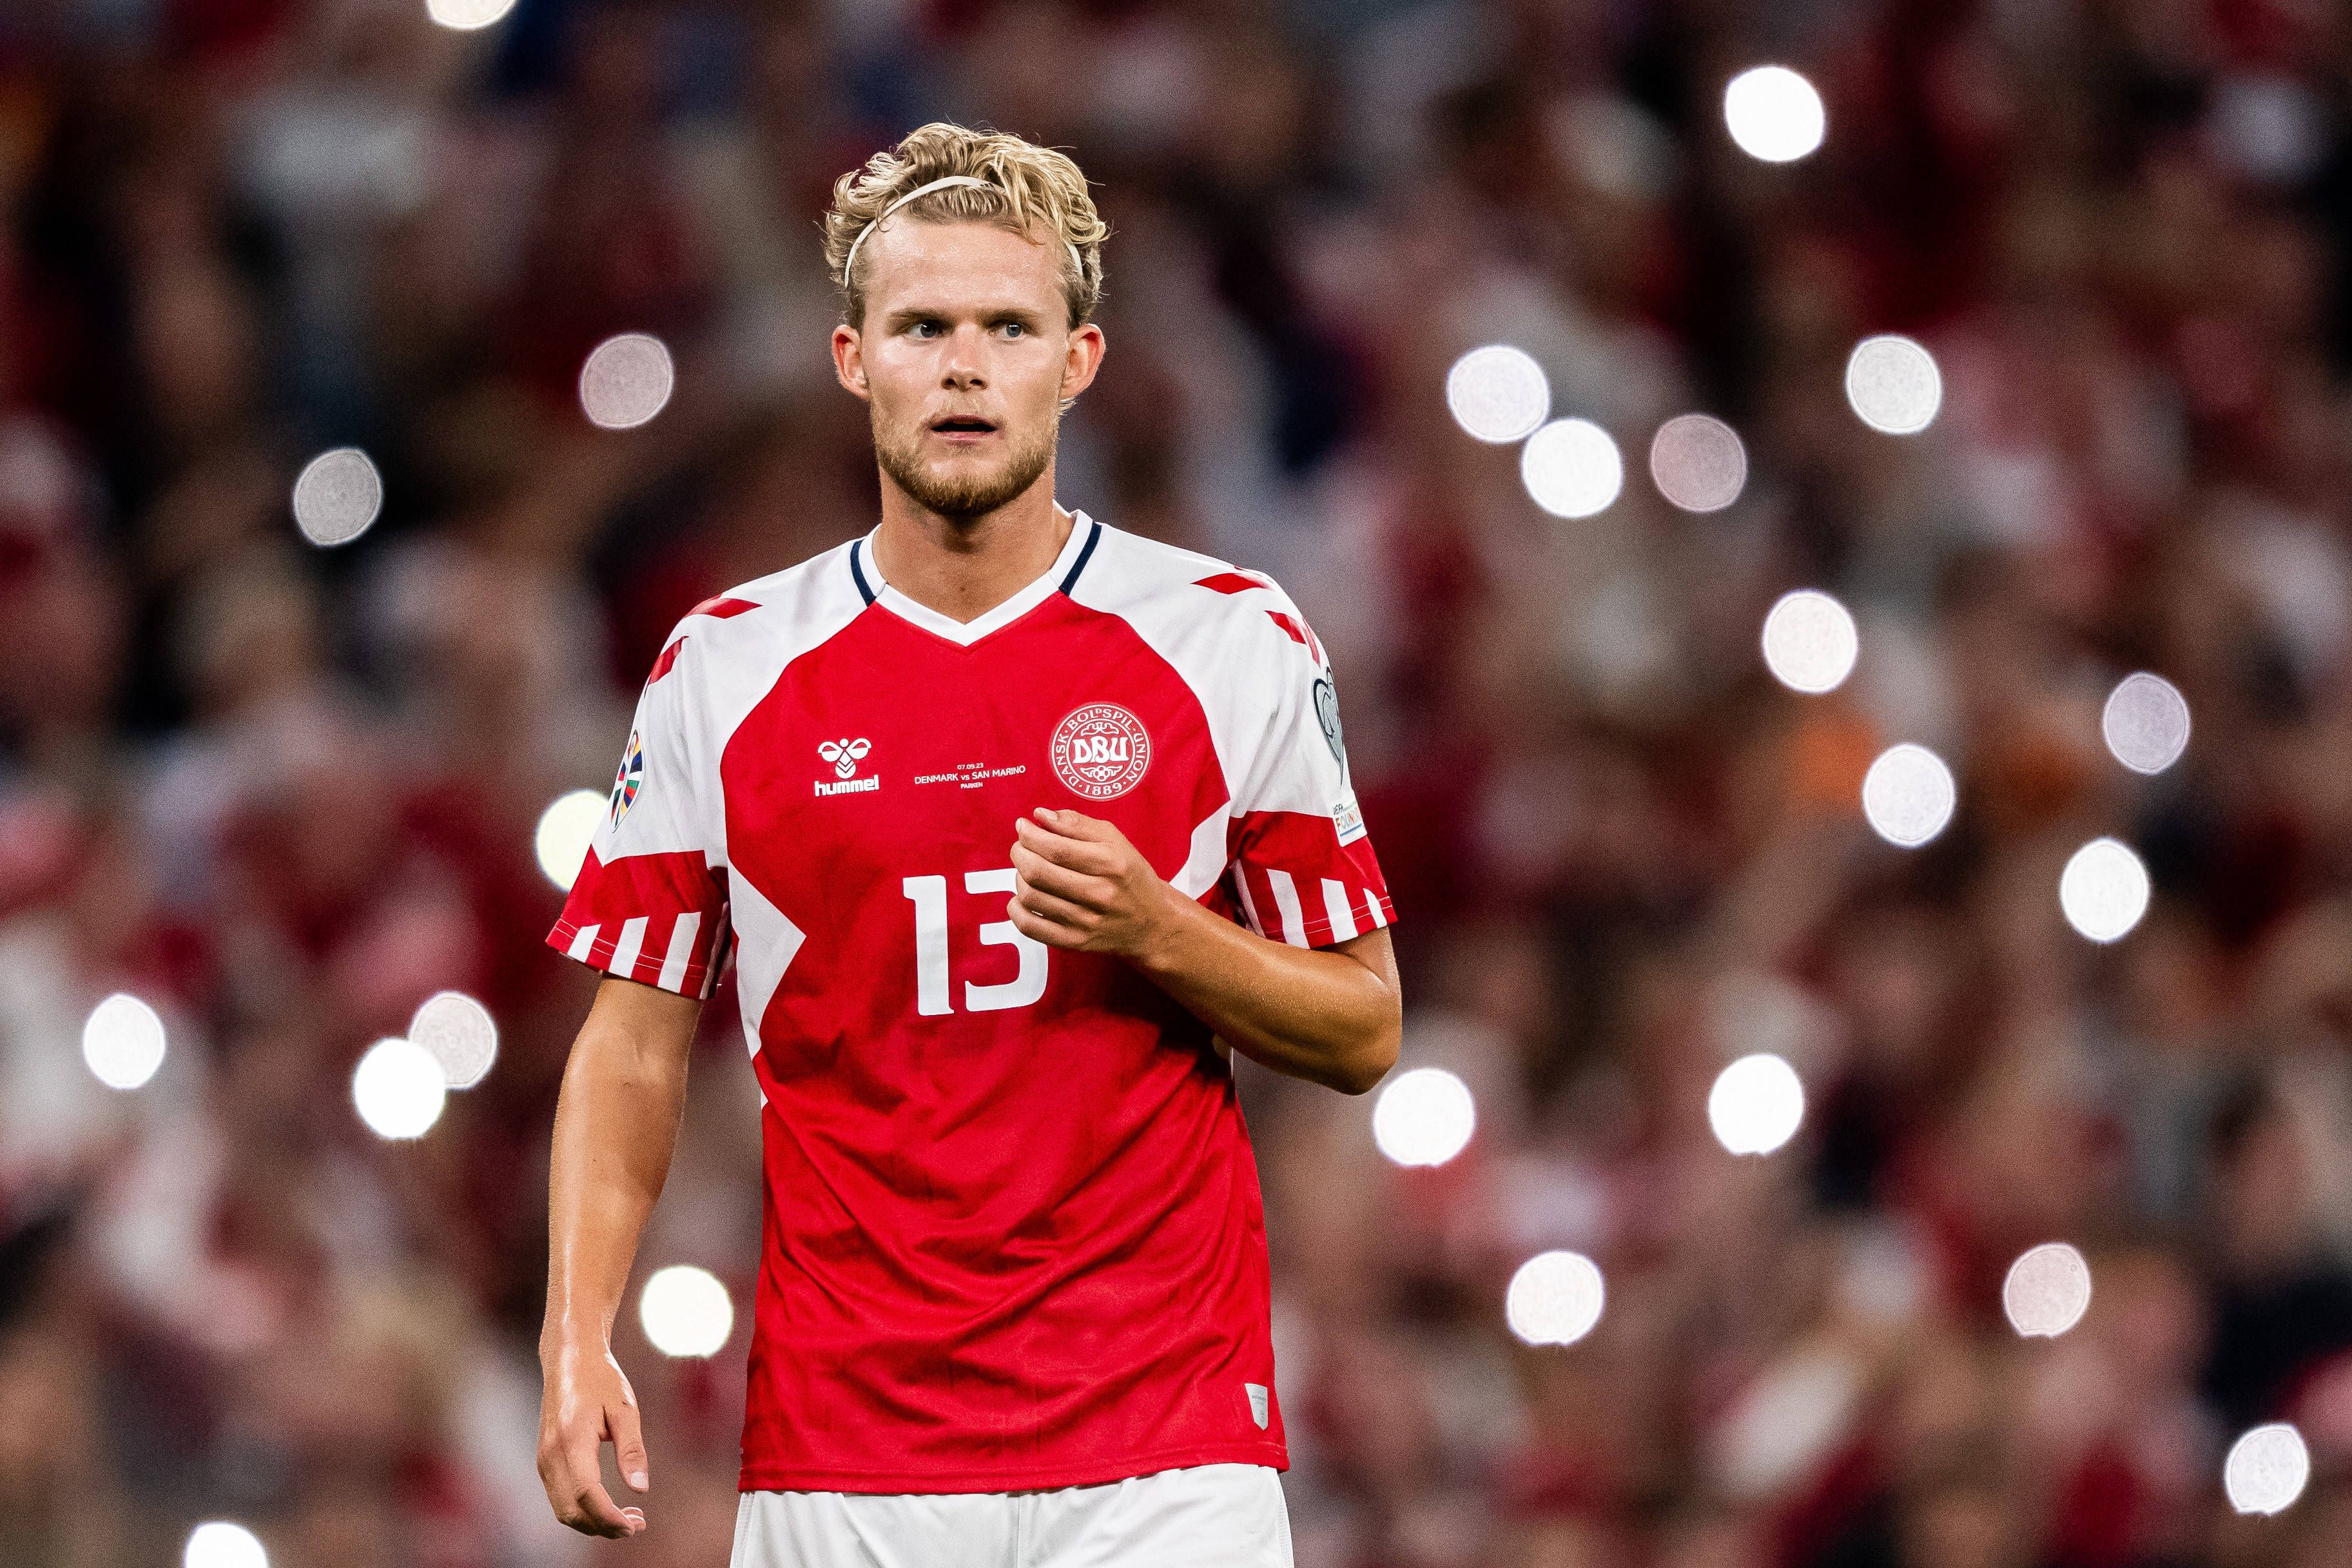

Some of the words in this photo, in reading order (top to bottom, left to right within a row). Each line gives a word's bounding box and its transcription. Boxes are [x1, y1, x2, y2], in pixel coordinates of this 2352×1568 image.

[1056, 733, 1080, 787] DANSK
[1073, 736, 1129, 764] DBU
[1125, 733, 1146, 782] UNION
[814, 775, 879, 797] hummel
[914, 773, 959, 784] DENMARK
[972, 770, 990, 780] SAN
[992, 765, 1026, 777] MARINO
[1085, 782, 1122, 795] 1889
[903, 867, 1048, 1016] 13
